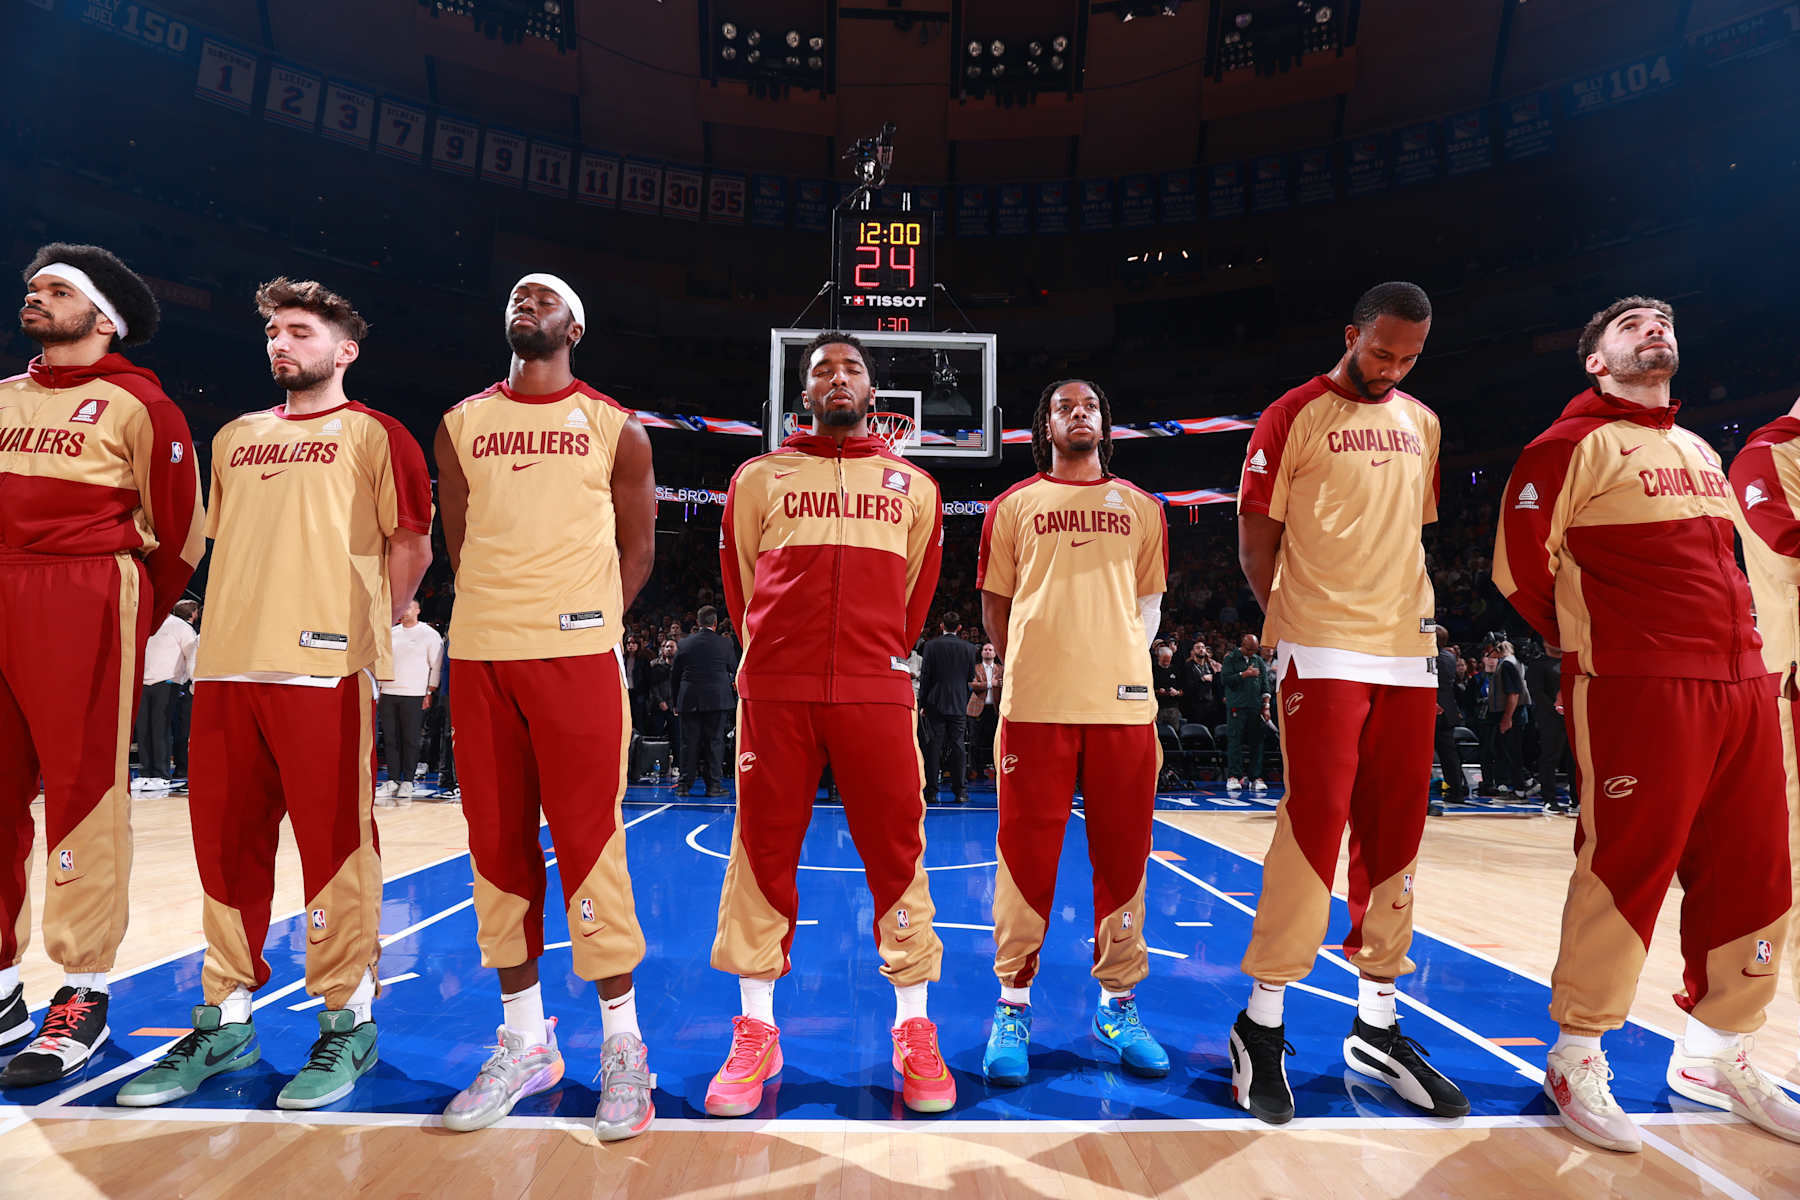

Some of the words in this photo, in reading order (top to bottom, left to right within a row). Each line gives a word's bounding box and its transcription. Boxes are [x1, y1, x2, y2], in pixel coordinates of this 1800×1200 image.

[121, 5, 189, 51] 150
[217, 65, 233, 95] 1
[1609, 55, 1672, 98] 104
[281, 87, 304, 115] 2
[338, 104, 359, 130] 3
[392, 119, 412, 146] 7
[447, 135, 465, 161] 9
[495, 147, 513, 172] 9
[536, 158, 561, 185] 11
[585, 170, 608, 194] 11
[627, 175, 656, 201] 19
[670, 182, 699, 209] 30
[711, 189, 742, 213] 35
[860, 222, 921, 245] 12:00
[855, 246, 915, 288] 24
[866, 295, 927, 307] TISSOT
[229, 441, 339, 468] CAVALIERS
[472, 431, 590, 459] CAVALIERS
[1327, 428, 1422, 456] CAVALIERS
[783, 491, 904, 525] CAVALIERS
[1033, 510, 1131, 536] CAVALIERS
